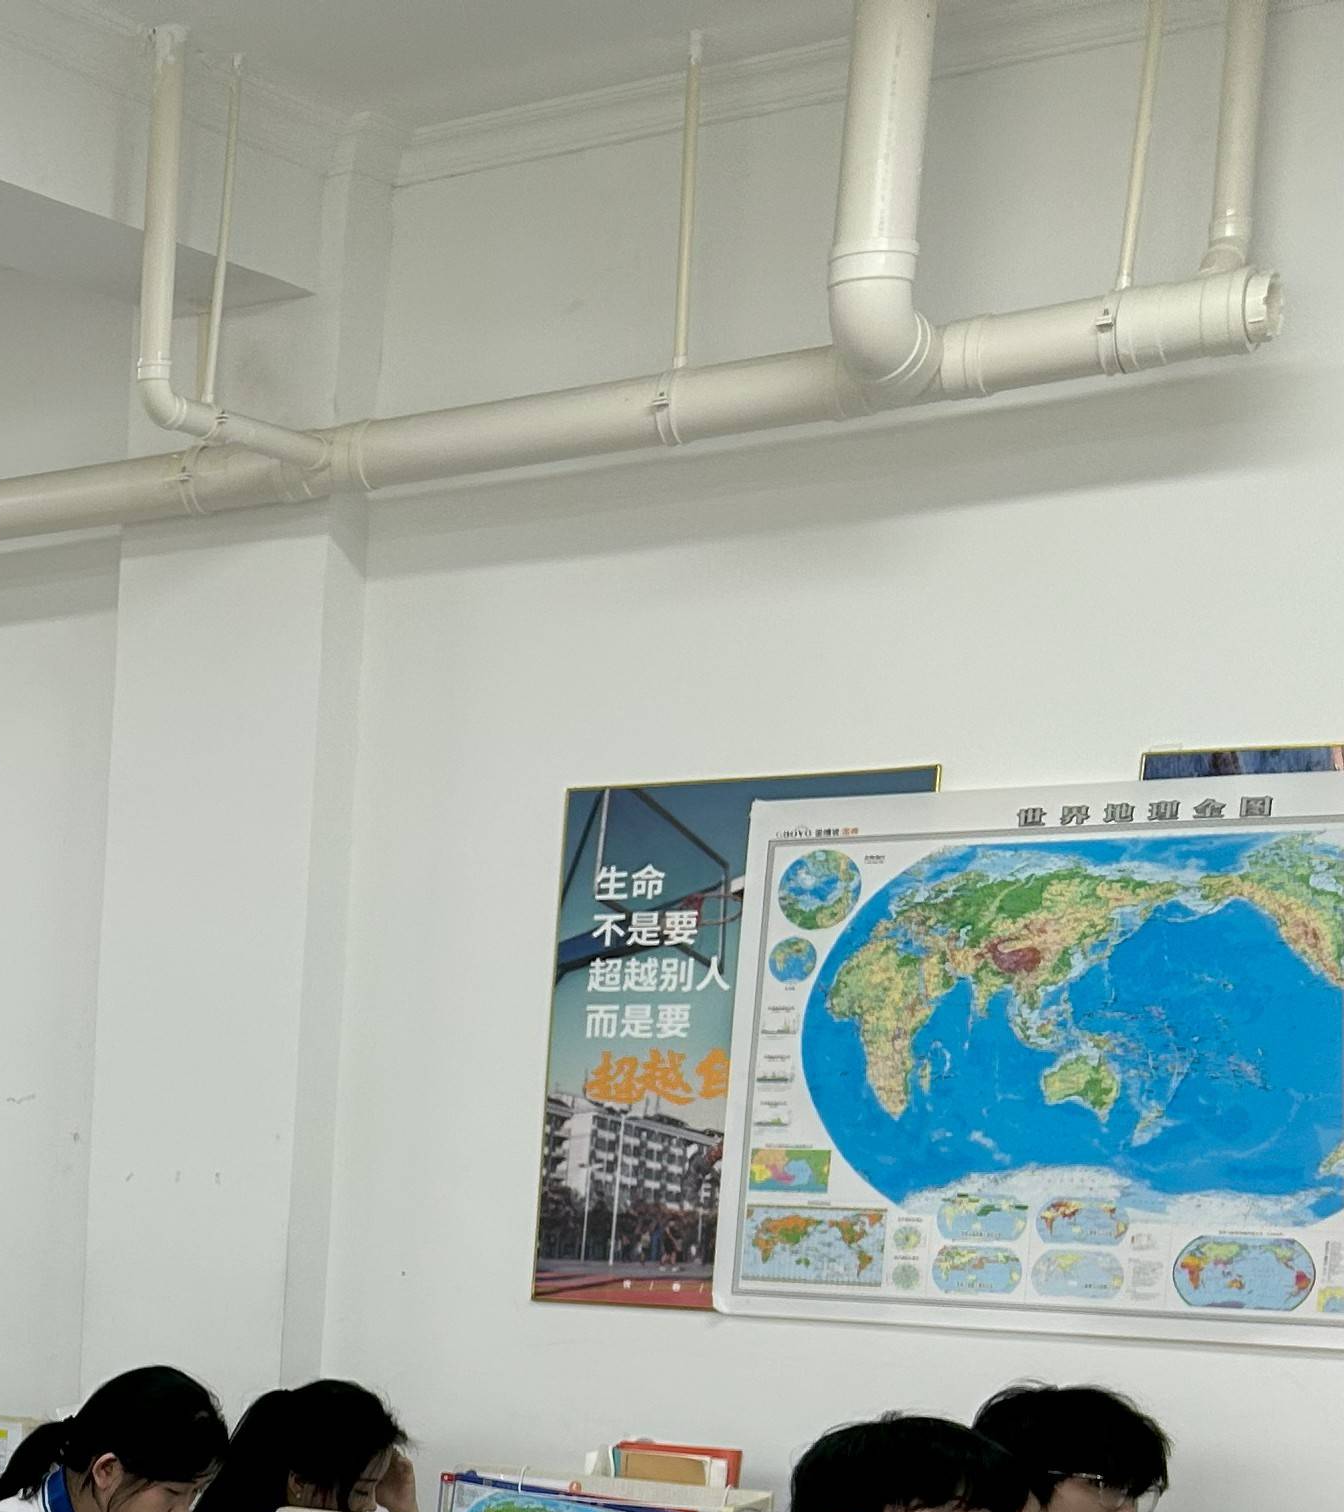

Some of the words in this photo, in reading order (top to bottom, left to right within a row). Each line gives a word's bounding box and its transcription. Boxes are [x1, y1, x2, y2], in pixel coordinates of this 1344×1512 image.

[1016, 795, 1274, 828] 世界地理全图
[595, 864, 665, 901] 生命
[592, 909, 699, 947] 不是要
[587, 956, 731, 993] 超越别人
[585, 1004, 692, 1039] 而是要
